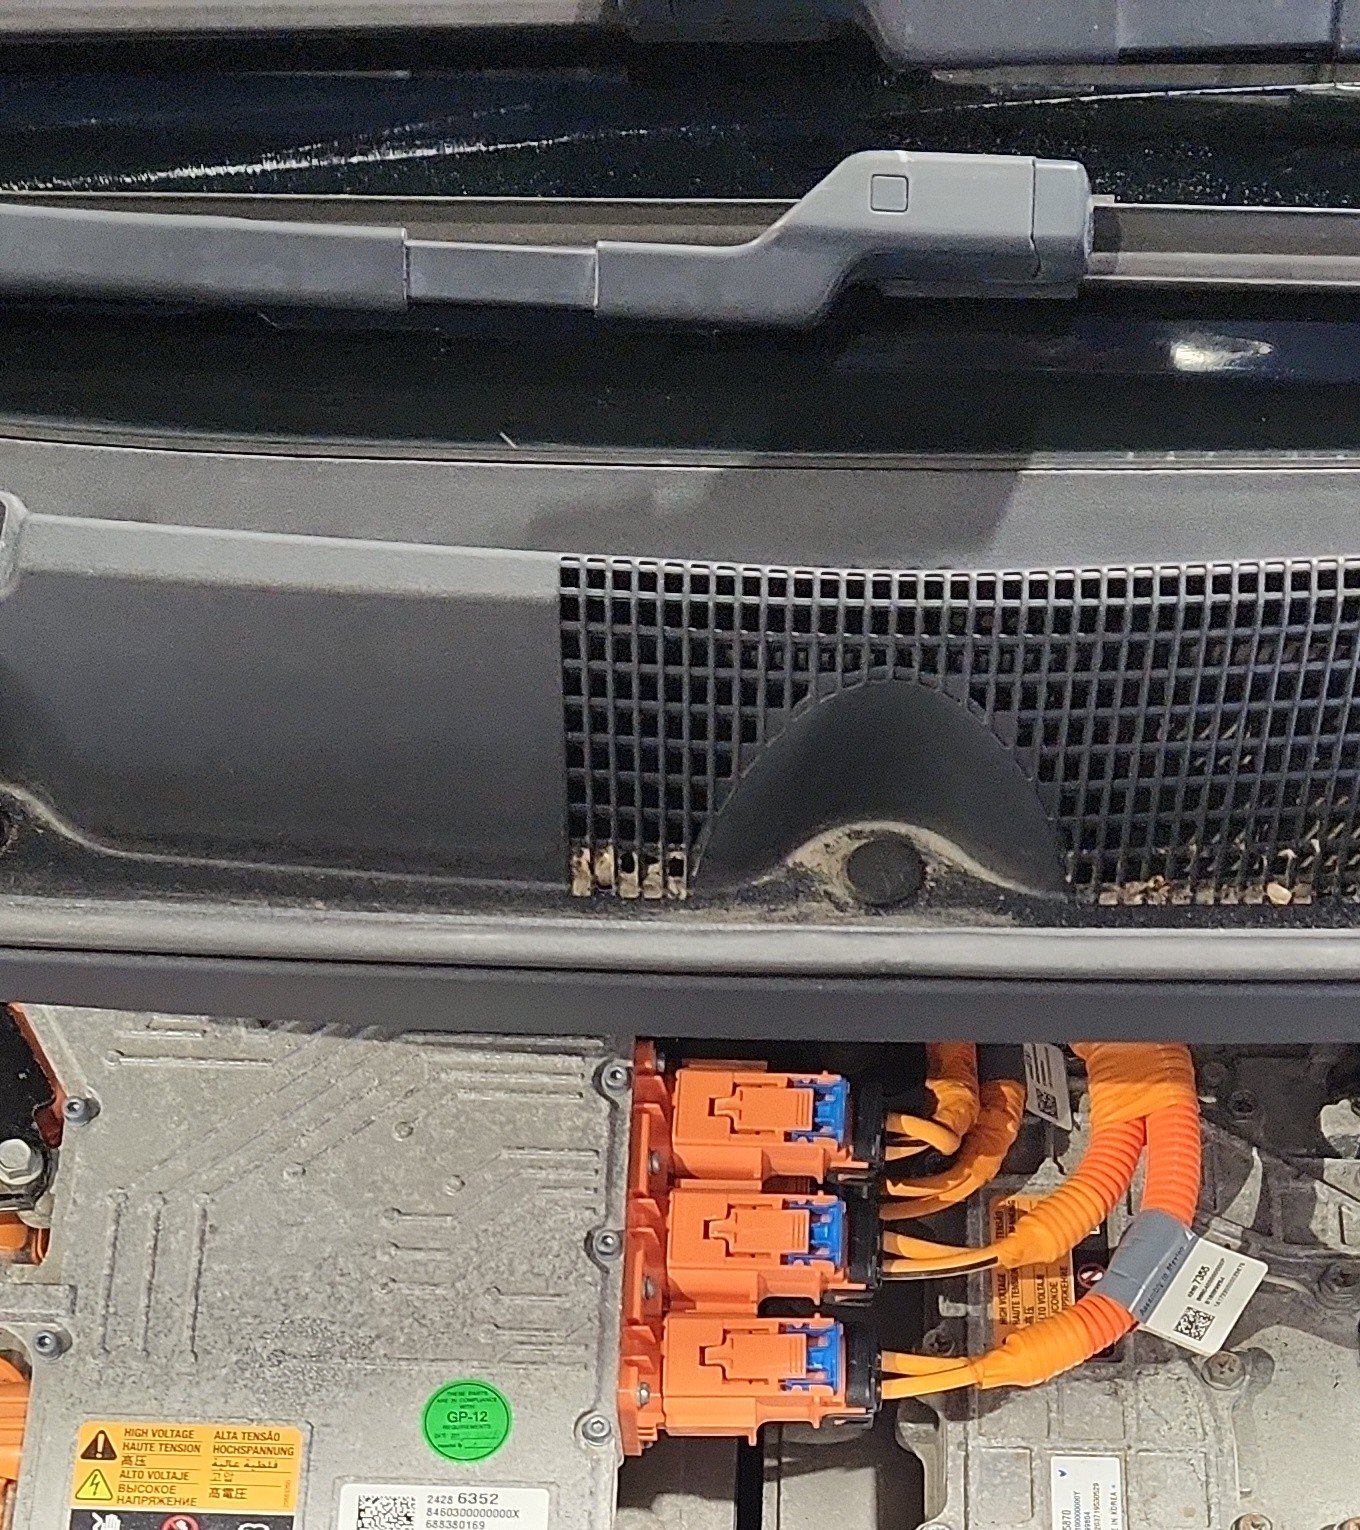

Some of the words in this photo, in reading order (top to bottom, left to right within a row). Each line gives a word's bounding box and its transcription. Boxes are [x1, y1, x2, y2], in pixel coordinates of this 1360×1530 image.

[1192, 1265, 1211, 1285] 7355
[446, 1410, 488, 1423] GP-12
[124, 1428, 149, 1439] HIGH
[151, 1429, 195, 1439] VOLTAGE
[213, 1430, 239, 1441] ALTA
[122, 1442, 155, 1452] HAUTE
[158, 1443, 202, 1454] TENSION
[212, 1445, 295, 1456] HOCHSPANNUNG
[121, 1454, 147, 1467] 高压
[119, 1469, 144, 1480] ALTO
[147, 1471, 190, 1481] VOLTAJE
[117, 1483, 178, 1495] ВЫСОКОЕ
[115, 1495, 198, 1507] НАПРЯЖЕНИЕ
[426, 1494, 454, 1505] 2428
[457, 1492, 499, 1506] 6352
[1110, 1491, 1118, 1517] KOREA
[1110, 1517, 1118, 1526] IN
